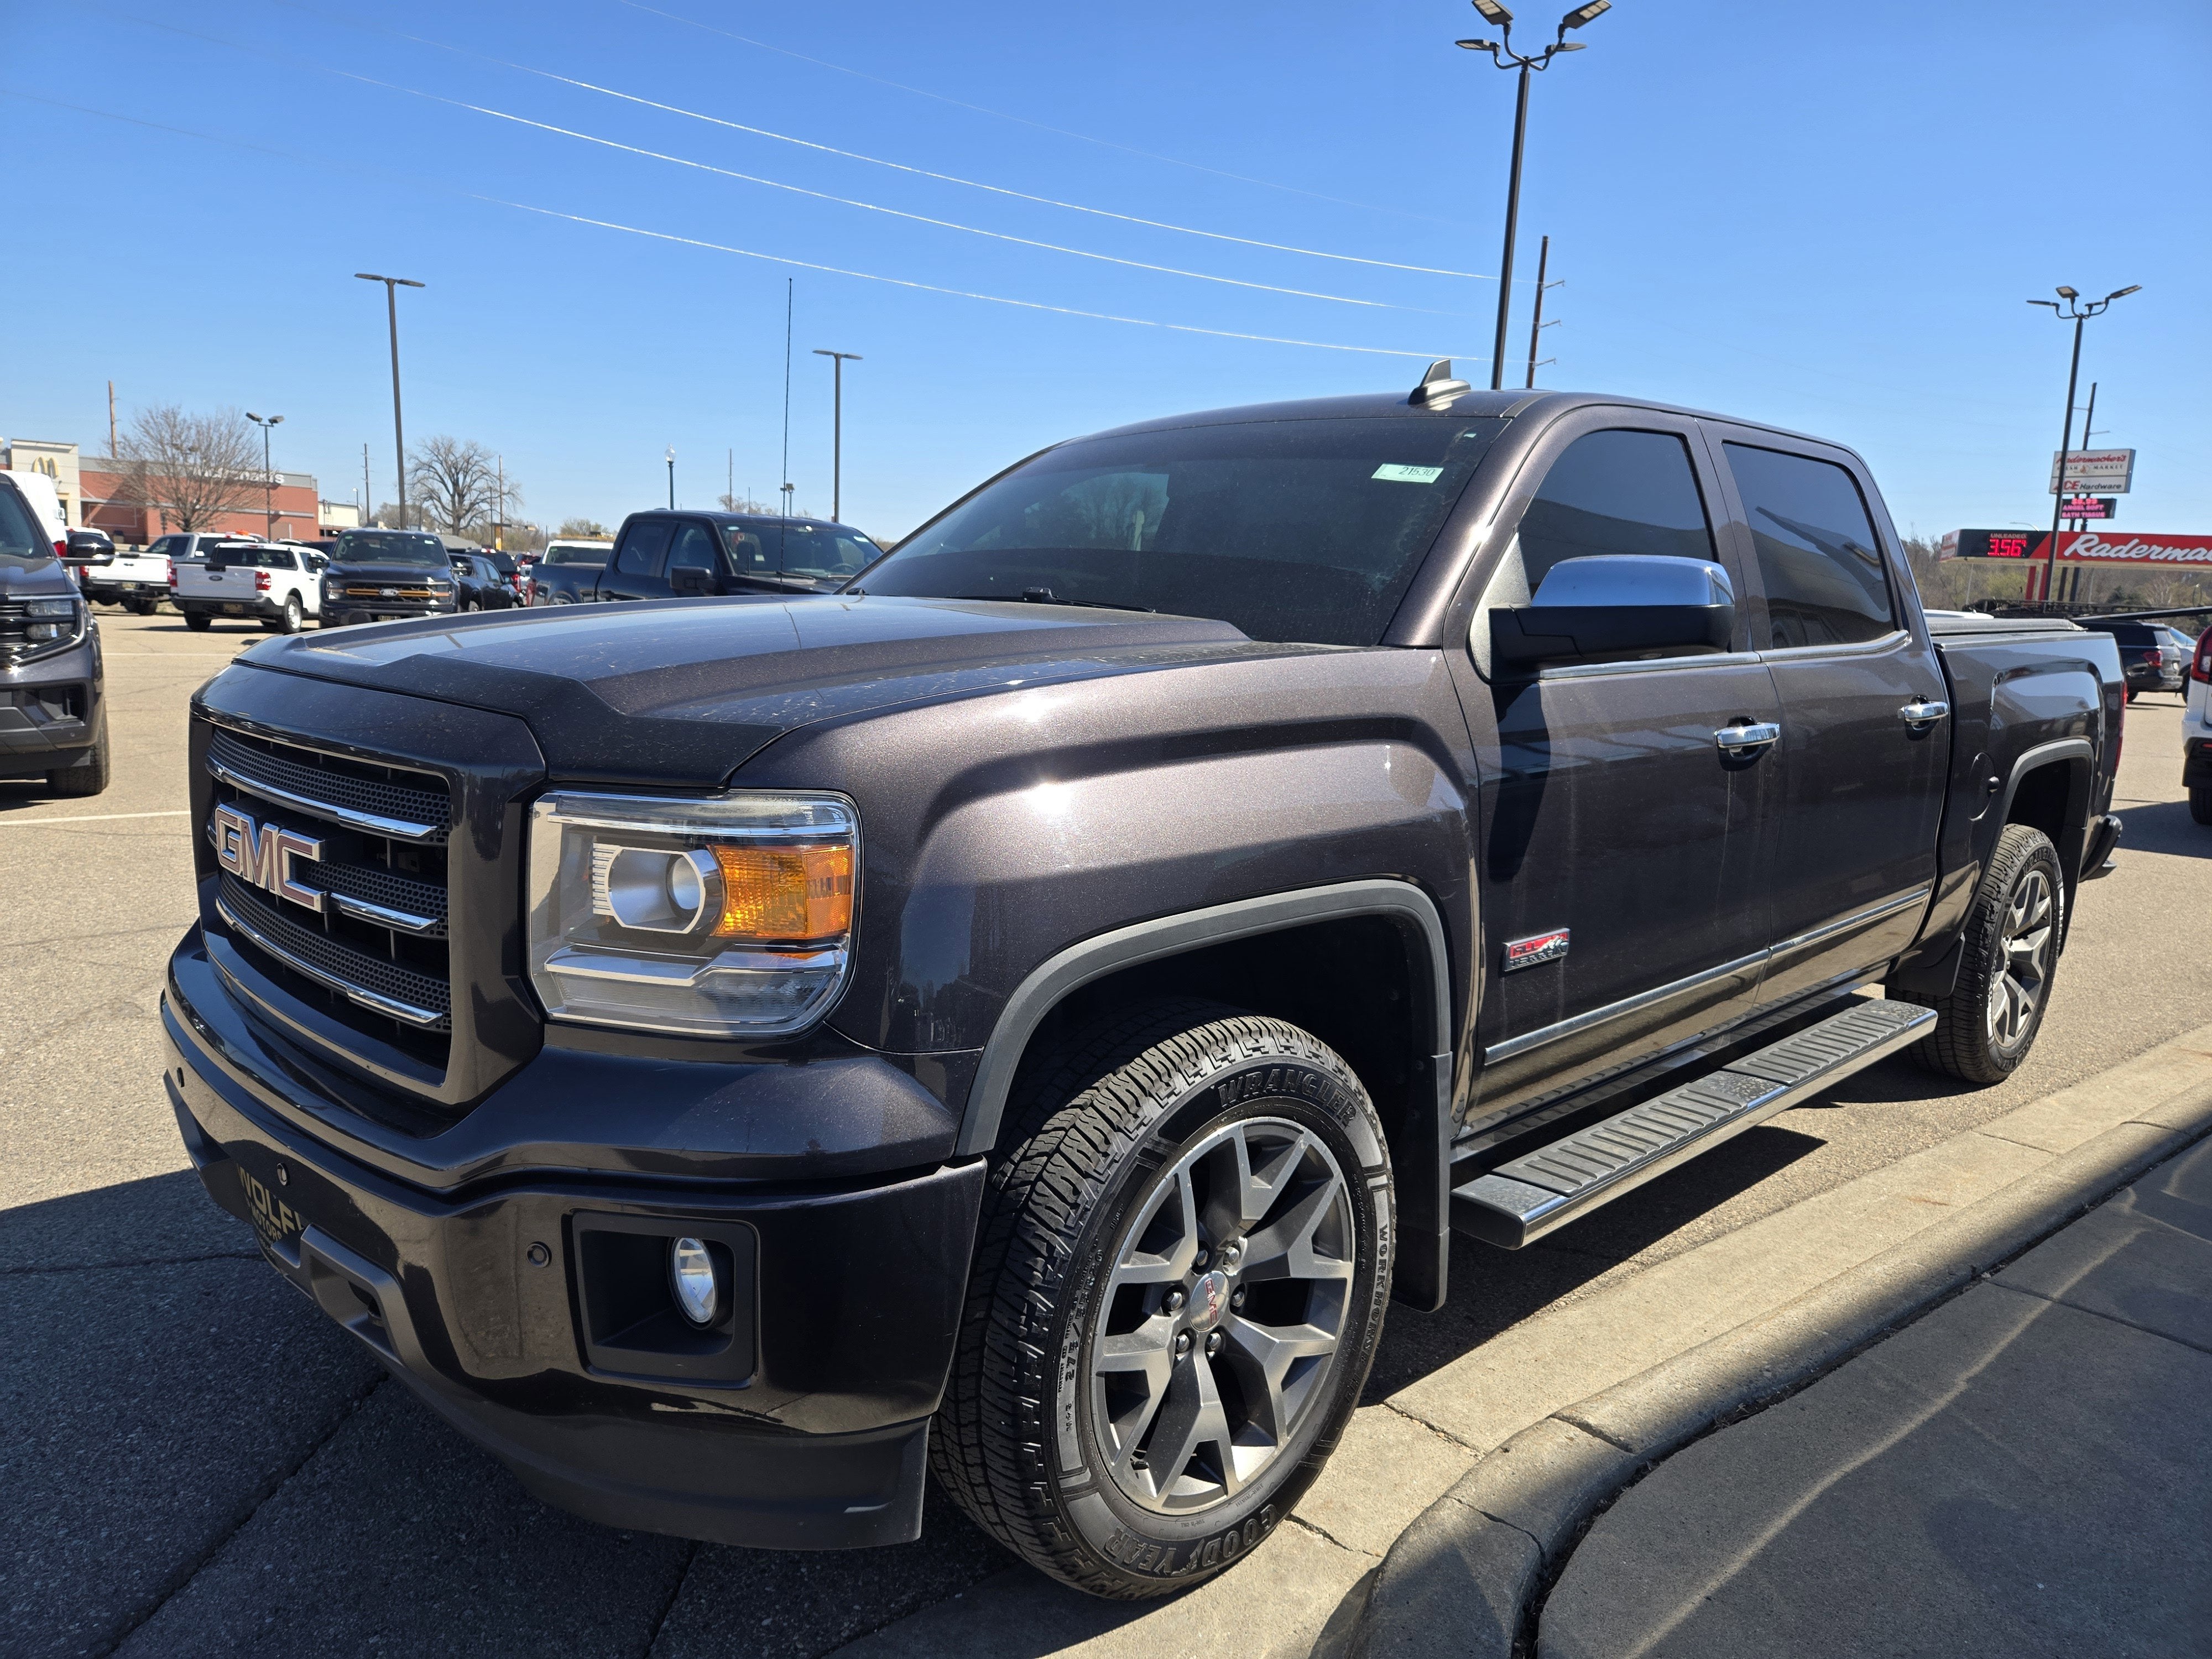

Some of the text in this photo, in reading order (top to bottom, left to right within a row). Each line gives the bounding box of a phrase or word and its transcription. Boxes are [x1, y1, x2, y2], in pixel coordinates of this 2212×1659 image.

[1399, 467, 1436, 476] 21530
[215, 804, 327, 912] GMC
[1217, 1068, 1356, 1127] WRANGLER
[1204, 1277, 1218, 1325] GMC
[1361, 1224, 1389, 1363] WORKHORSE
